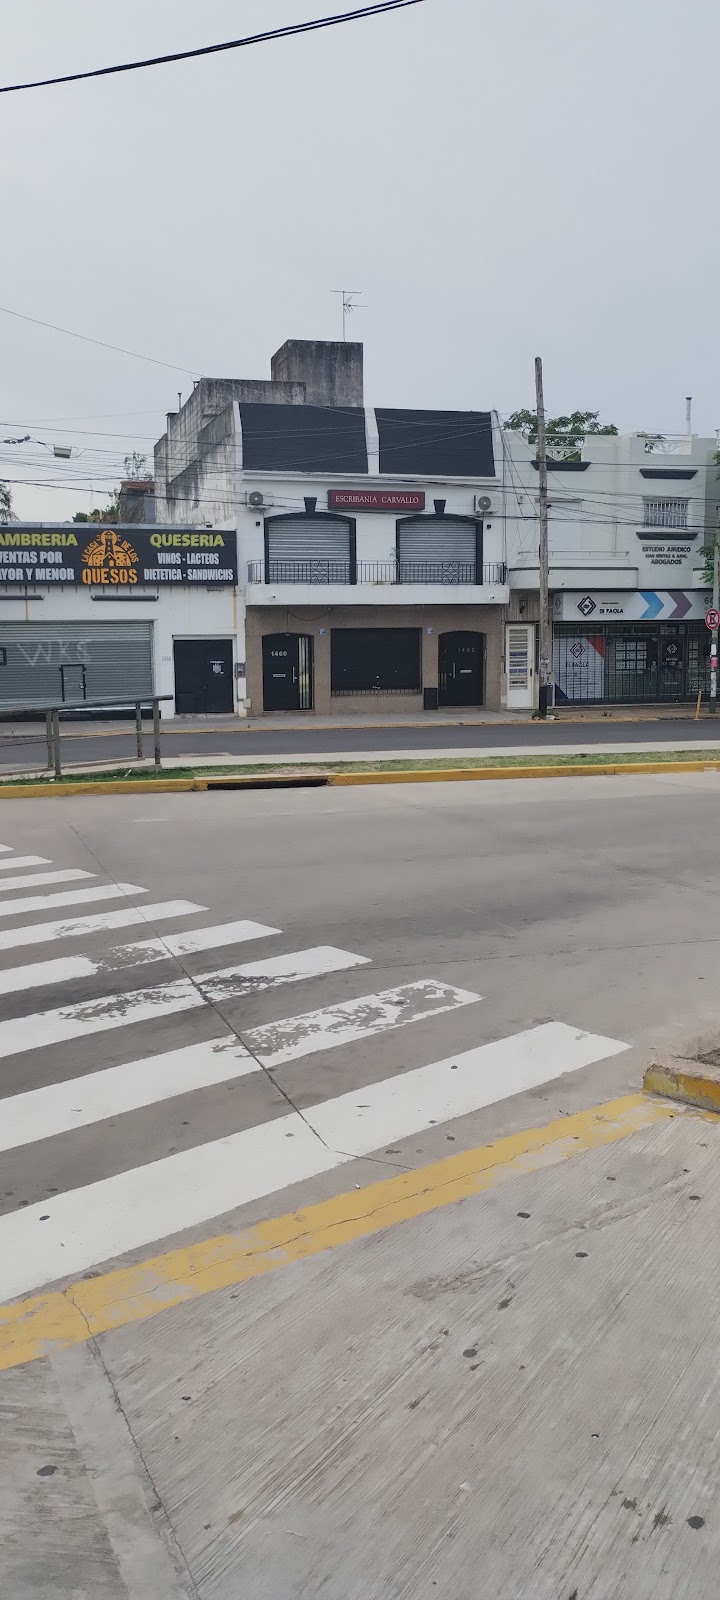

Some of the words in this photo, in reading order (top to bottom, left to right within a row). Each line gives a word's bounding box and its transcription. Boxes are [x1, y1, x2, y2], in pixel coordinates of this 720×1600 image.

[335, 495, 377, 503] ESCRIBANIA
[381, 496, 419, 504] CARVALLO
[150, 533, 225, 548] QUESERIA
[40, 551, 63, 564] POR
[157, 552, 181, 565] VINOS
[187, 552, 219, 565] LACTEOS
[25, 568, 33, 580] Y
[35, 568, 75, 580] MENOR
[82, 568, 138, 585] QUESOS
[143, 568, 182, 580] DIETETICA
[187, 568, 234, 581] SANDWICHS
